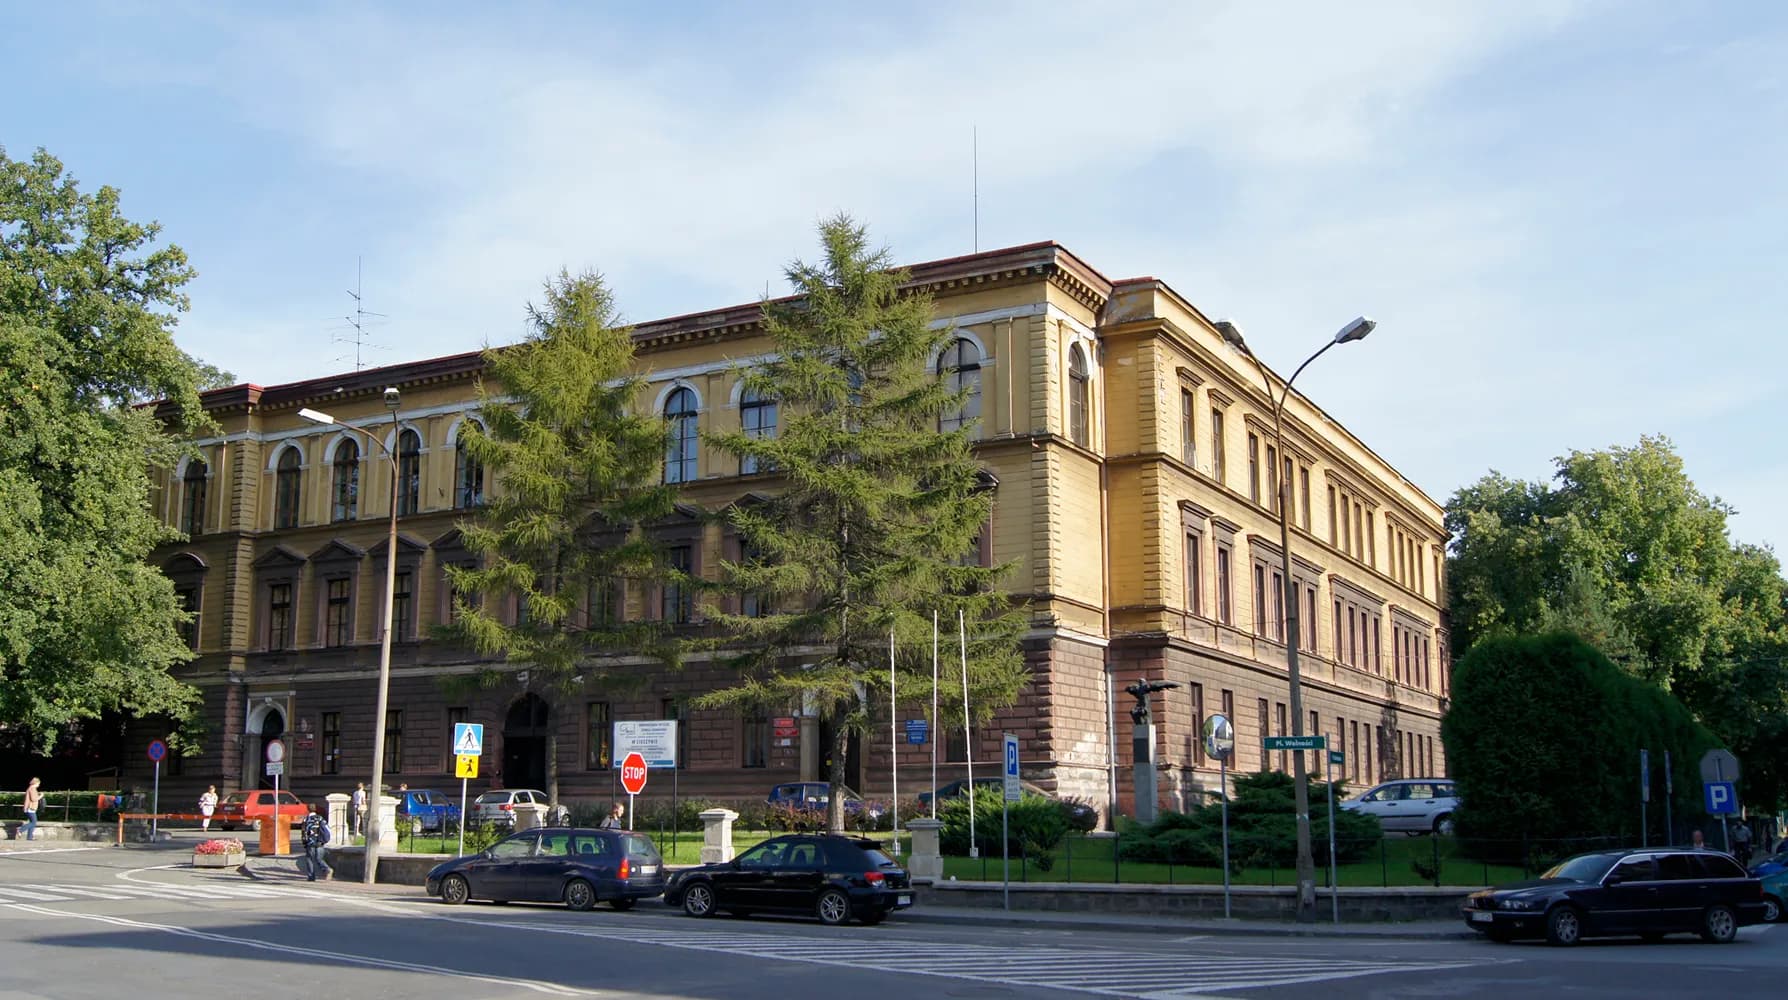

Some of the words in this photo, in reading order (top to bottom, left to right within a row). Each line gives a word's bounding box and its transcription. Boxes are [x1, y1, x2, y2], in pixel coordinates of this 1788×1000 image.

[1009, 744, 1015, 771] P
[624, 767, 644, 780] STOP
[1710, 785, 1727, 809] P
